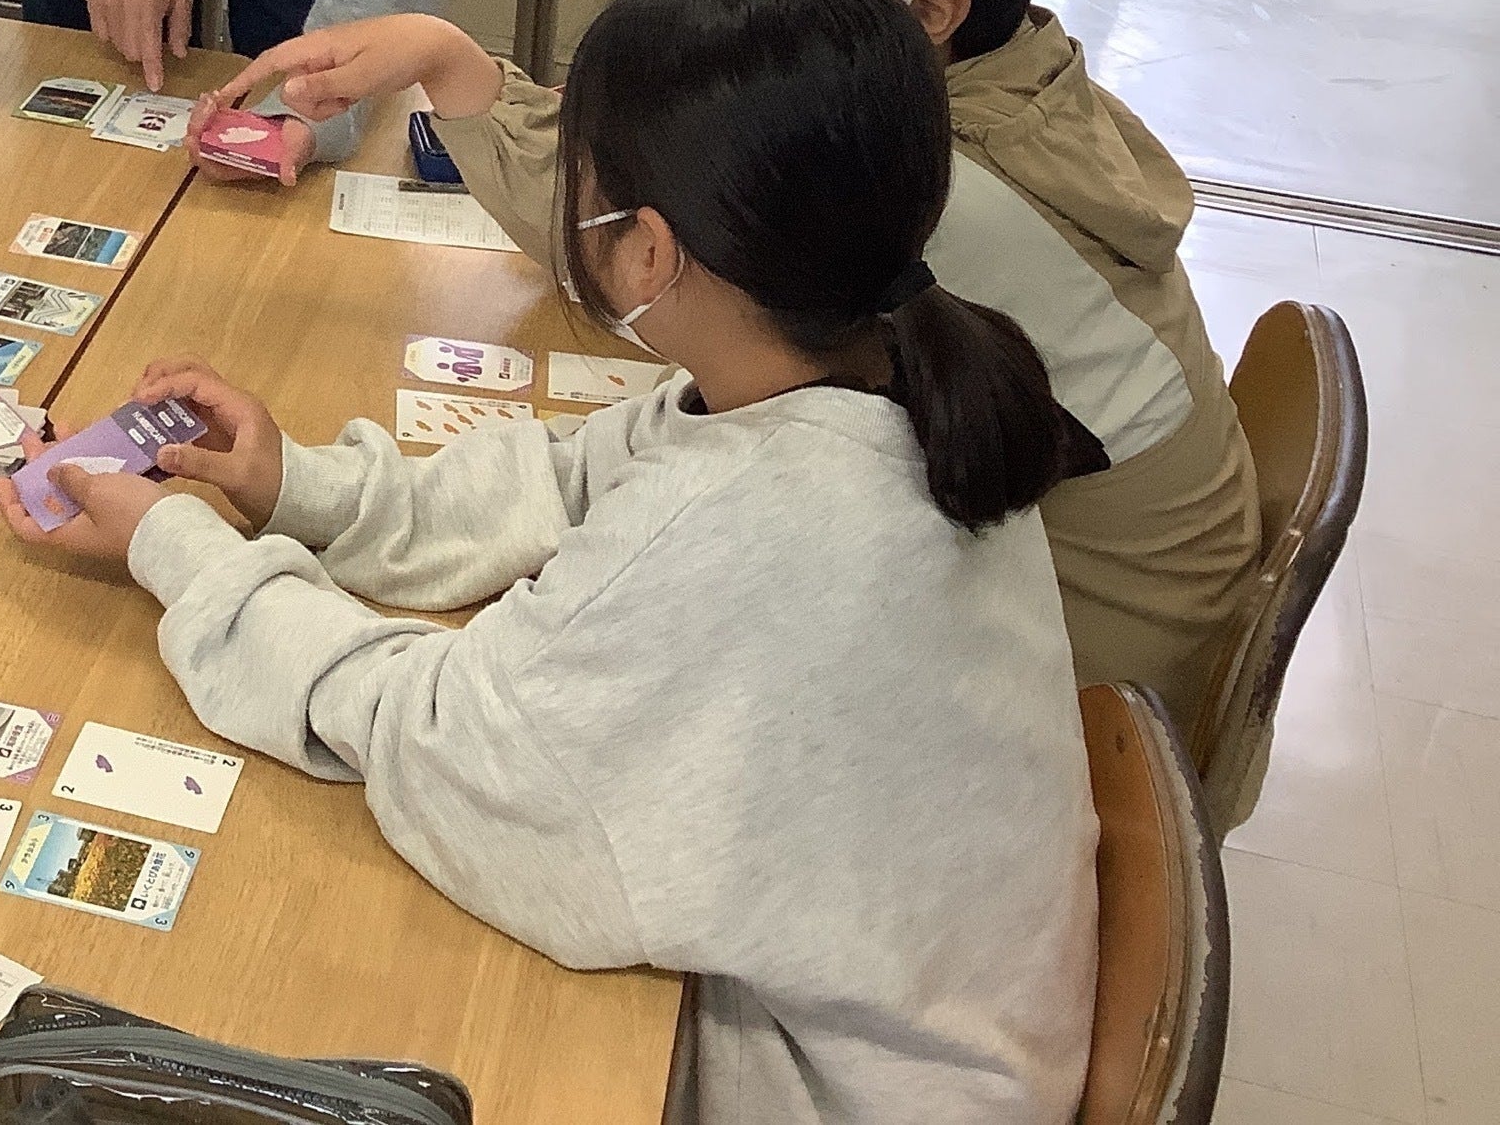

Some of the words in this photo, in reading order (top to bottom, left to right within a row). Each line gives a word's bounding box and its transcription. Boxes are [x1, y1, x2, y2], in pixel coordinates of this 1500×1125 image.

[222, 759, 237, 768] 2
[61, 785, 75, 794] 2
[38, 813, 50, 822] 3
[155, 917, 168, 926] 3
